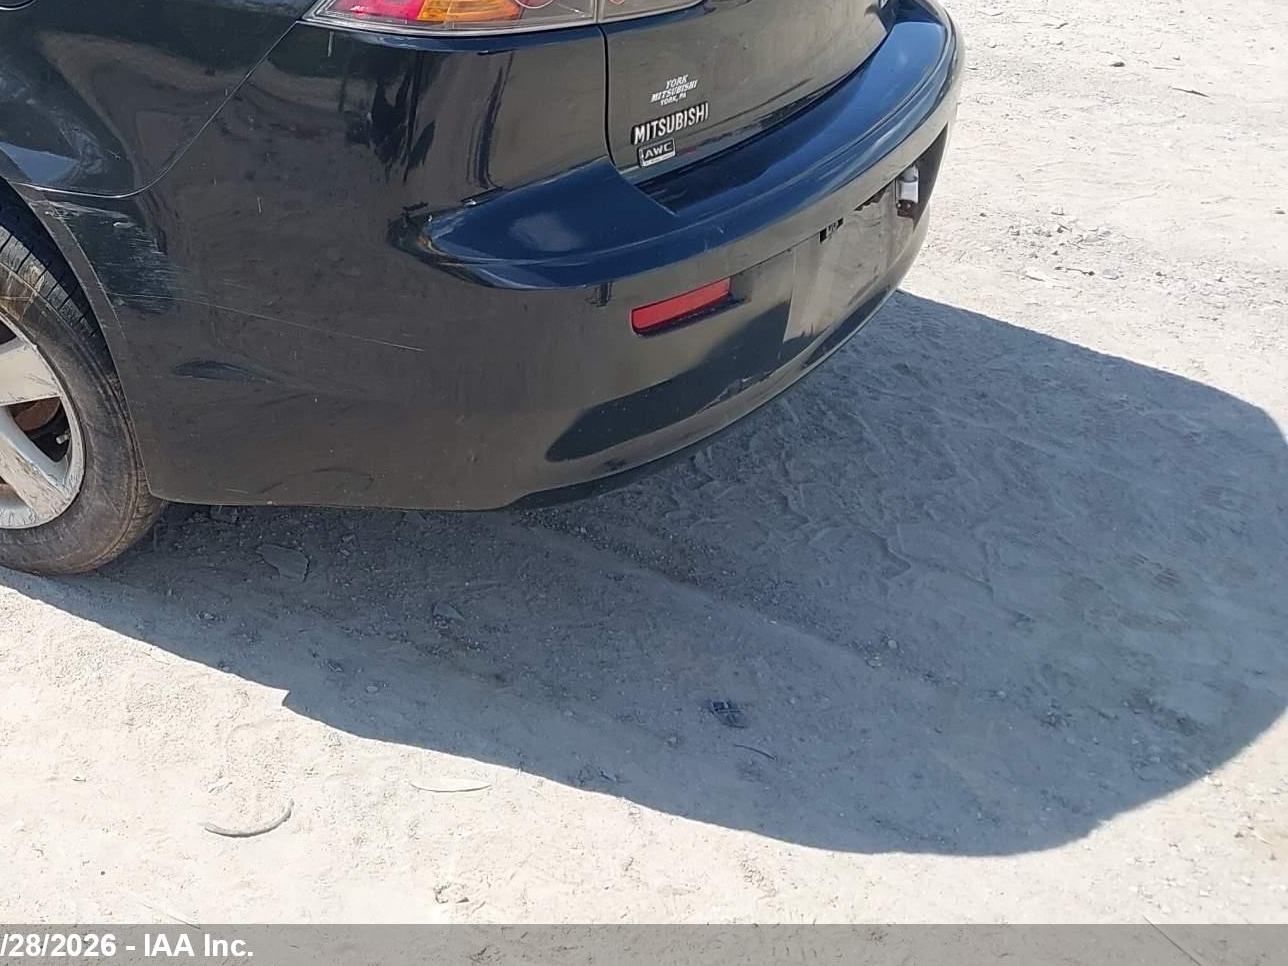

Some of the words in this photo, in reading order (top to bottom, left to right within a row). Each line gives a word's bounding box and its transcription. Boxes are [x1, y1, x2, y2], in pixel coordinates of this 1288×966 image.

[651, 79, 699, 103] MITSUBISHI
[665, 74, 689, 90] YORK
[633, 101, 709, 145] MITSUBISHI
[644, 141, 673, 160] AWC
